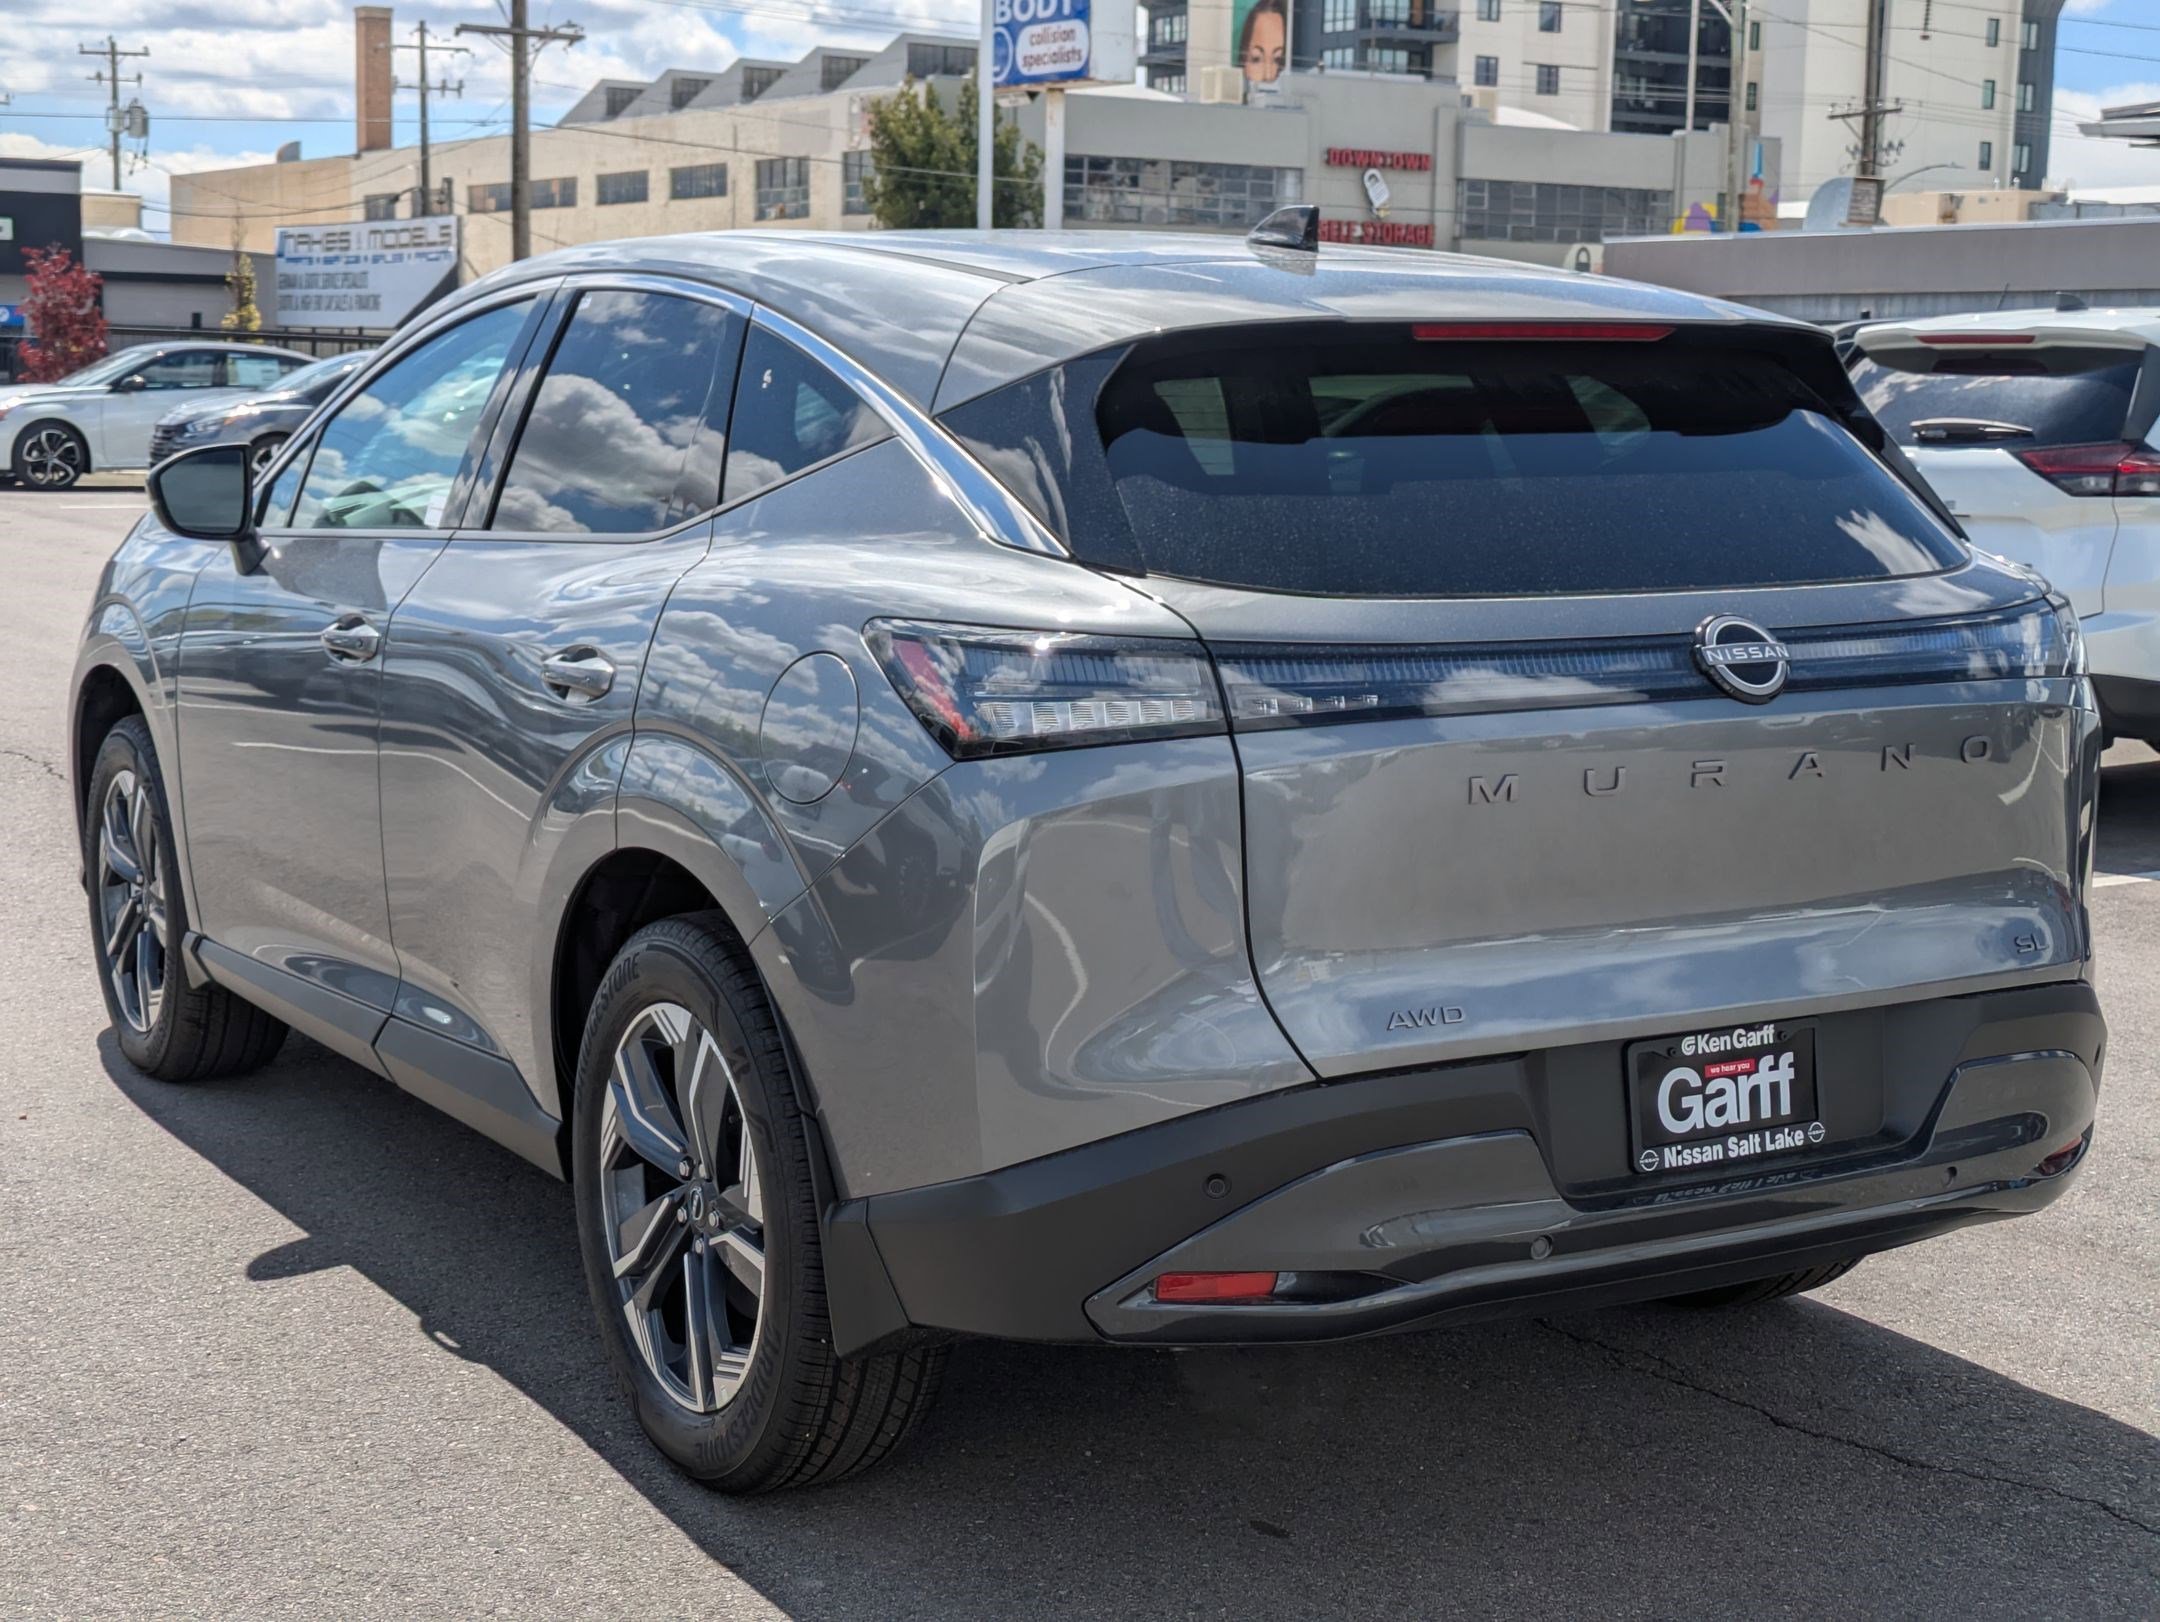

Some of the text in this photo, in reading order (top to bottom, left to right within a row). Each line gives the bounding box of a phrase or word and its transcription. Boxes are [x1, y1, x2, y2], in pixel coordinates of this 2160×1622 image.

[1326, 148, 1431, 171] DOWNTOWN
[1706, 646, 1790, 662] NISSAN
[1468, 735, 1993, 805] MURANO
[2014, 933, 2050, 954] SL
[1386, 1006, 1466, 1032] AWD
[1697, 1024, 1775, 1054] Ken Garff
[1721, 1064, 1736, 1073] hear
[1737, 1062, 1750, 1071] you
[1657, 1051, 1795, 1134] Garff
[1664, 1128, 1804, 1168] Nissan Salt Lake
